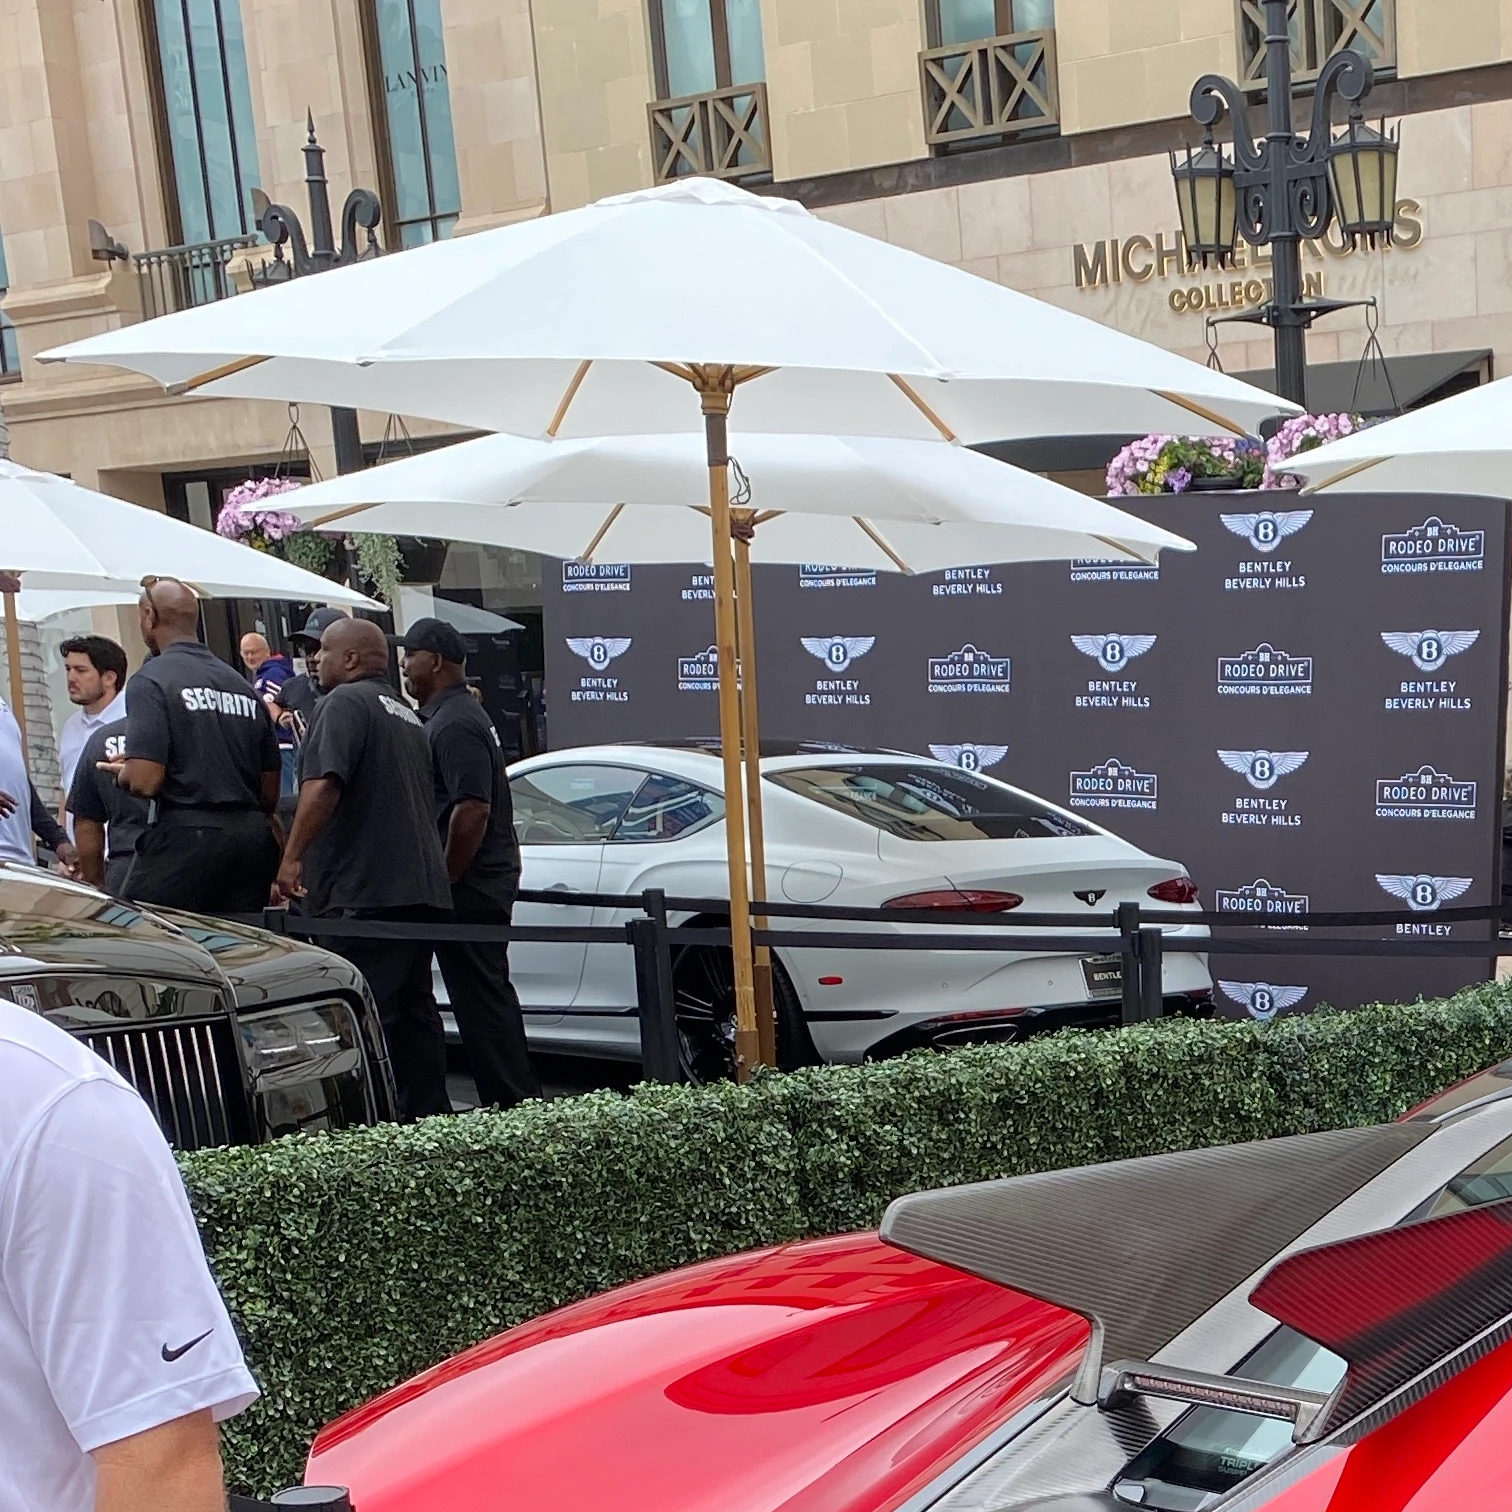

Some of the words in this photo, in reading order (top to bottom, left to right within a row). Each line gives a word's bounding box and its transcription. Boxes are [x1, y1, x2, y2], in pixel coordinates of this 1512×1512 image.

[1388, 540, 1433, 554] RODEO
[1438, 538, 1476, 553] DRIVE
[567, 564, 597, 577] RODEO
[1239, 561, 1292, 573] BENTLEY
[1381, 562, 1428, 573] CONCOURS
[1430, 560, 1484, 571] D'ELEGANCE
[944, 568, 990, 580] BENTLEY
[1070, 571, 1111, 581] CONCOURS
[1112, 571, 1160, 580] D'ELEGANCE
[692, 576, 715, 586] BENT
[799, 579, 835, 588] CONCOURS
[1224, 577, 1272, 589] BEVERLY
[1275, 575, 1306, 588] HILLS
[563, 583, 594, 592] CONCOURS
[932, 584, 973, 595] BEVERLY
[976, 583, 1003, 594] HILLS
[683, 664, 714, 675] RODEO
[934, 664, 969, 676] RODEO
[1224, 664, 1265, 677] RODEO
[1269, 664, 1305, 677] DRIVE
[581, 678, 618, 688] BENTLEY
[678, 682, 711, 691] CONCOURS
[816, 680, 859, 691] BENTLEY
[928, 684, 966, 693] CONCOURS
[966, 683, 1010, 693] D'ELEGANCE
[1088, 681, 1137, 692] BENTLEY
[1217, 684, 1261, 694] CONCOURS
[1262, 685, 1312, 694] D'ELEGANCE
[1400, 681, 1457, 693] BENTLEY
[571, 691, 604, 701] BEVERLY
[606, 691, 629, 701] HILLS
[805, 694, 843, 705] BEVERLY
[846, 694, 870, 705] HILLS
[1075, 696, 1119, 707] BEVERLY
[1121, 696, 1150, 708] HILLS
[181, 687, 258, 721] SECURITY
[1385, 698, 1435, 709] BEVERLY
[1438, 698, 1471, 709] HILLS
[1076, 778, 1113, 791] RODEO
[1117, 779, 1150, 792] DRIVE
[1383, 786, 1426, 800] RODEO
[1431, 787, 1467, 800] DRIVE
[1069, 797, 1110, 808] CONCOURS
[1111, 798, 1157, 809] D'ELEGANCE
[1235, 798, 1288, 810] BENTLEY
[1221, 812, 1267, 825] BEVERLY
[1271, 814, 1301, 826] HILLS
[1376, 807, 1421, 817] CONCOURS
[1424, 809, 1475, 819] D'ELEGANCE
[1222, 897, 1262, 912] RODEO
[1396, 923, 1451, 936] BENTLEY
[1093, 971, 1122, 981] BENTLE
